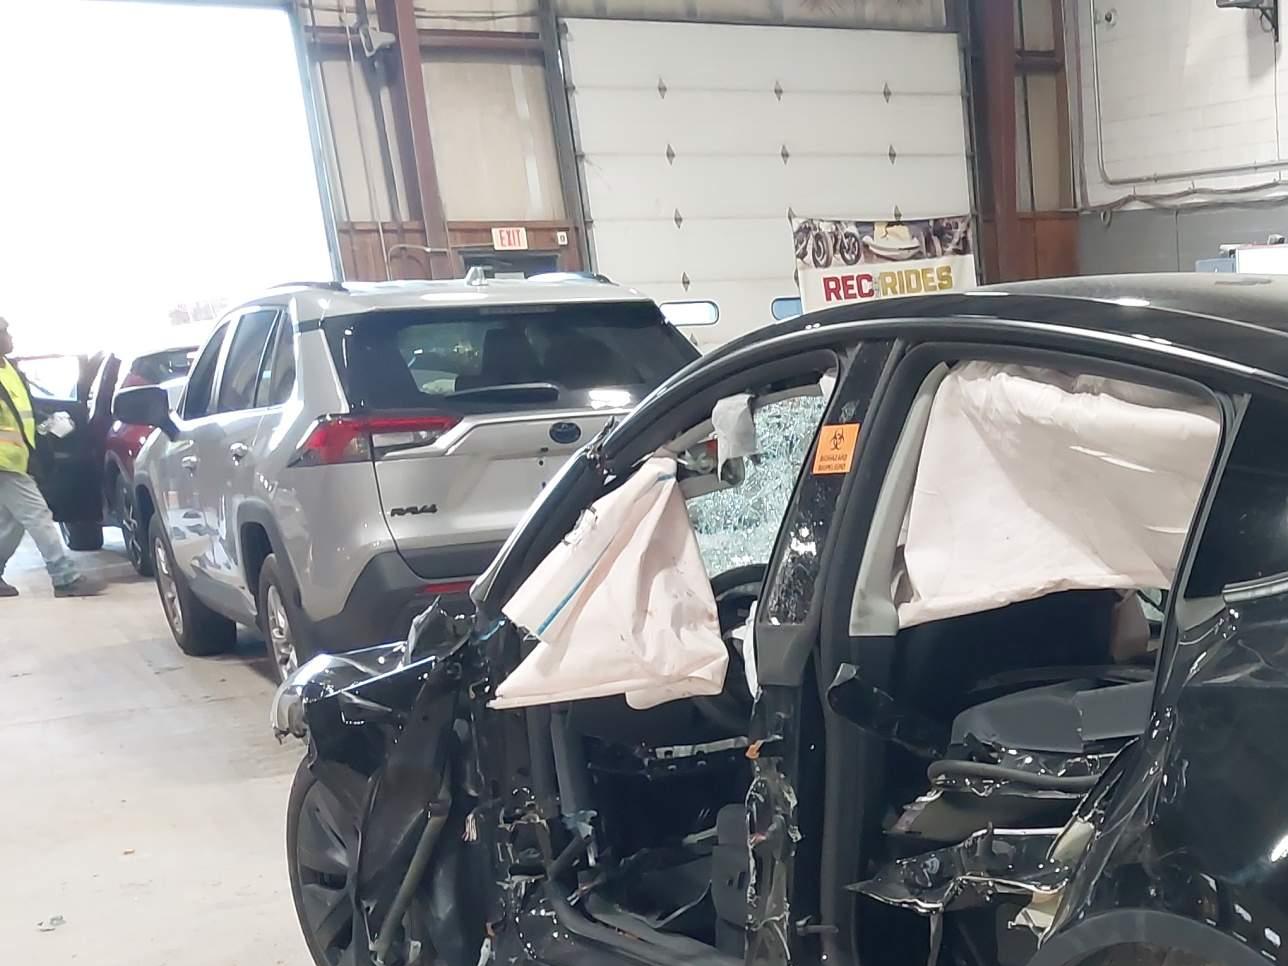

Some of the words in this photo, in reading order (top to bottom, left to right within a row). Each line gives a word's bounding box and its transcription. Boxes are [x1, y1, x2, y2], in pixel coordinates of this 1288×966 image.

[499, 229, 521, 247] EXIT
[823, 273, 875, 302] REC
[879, 266, 953, 296] RIDES
